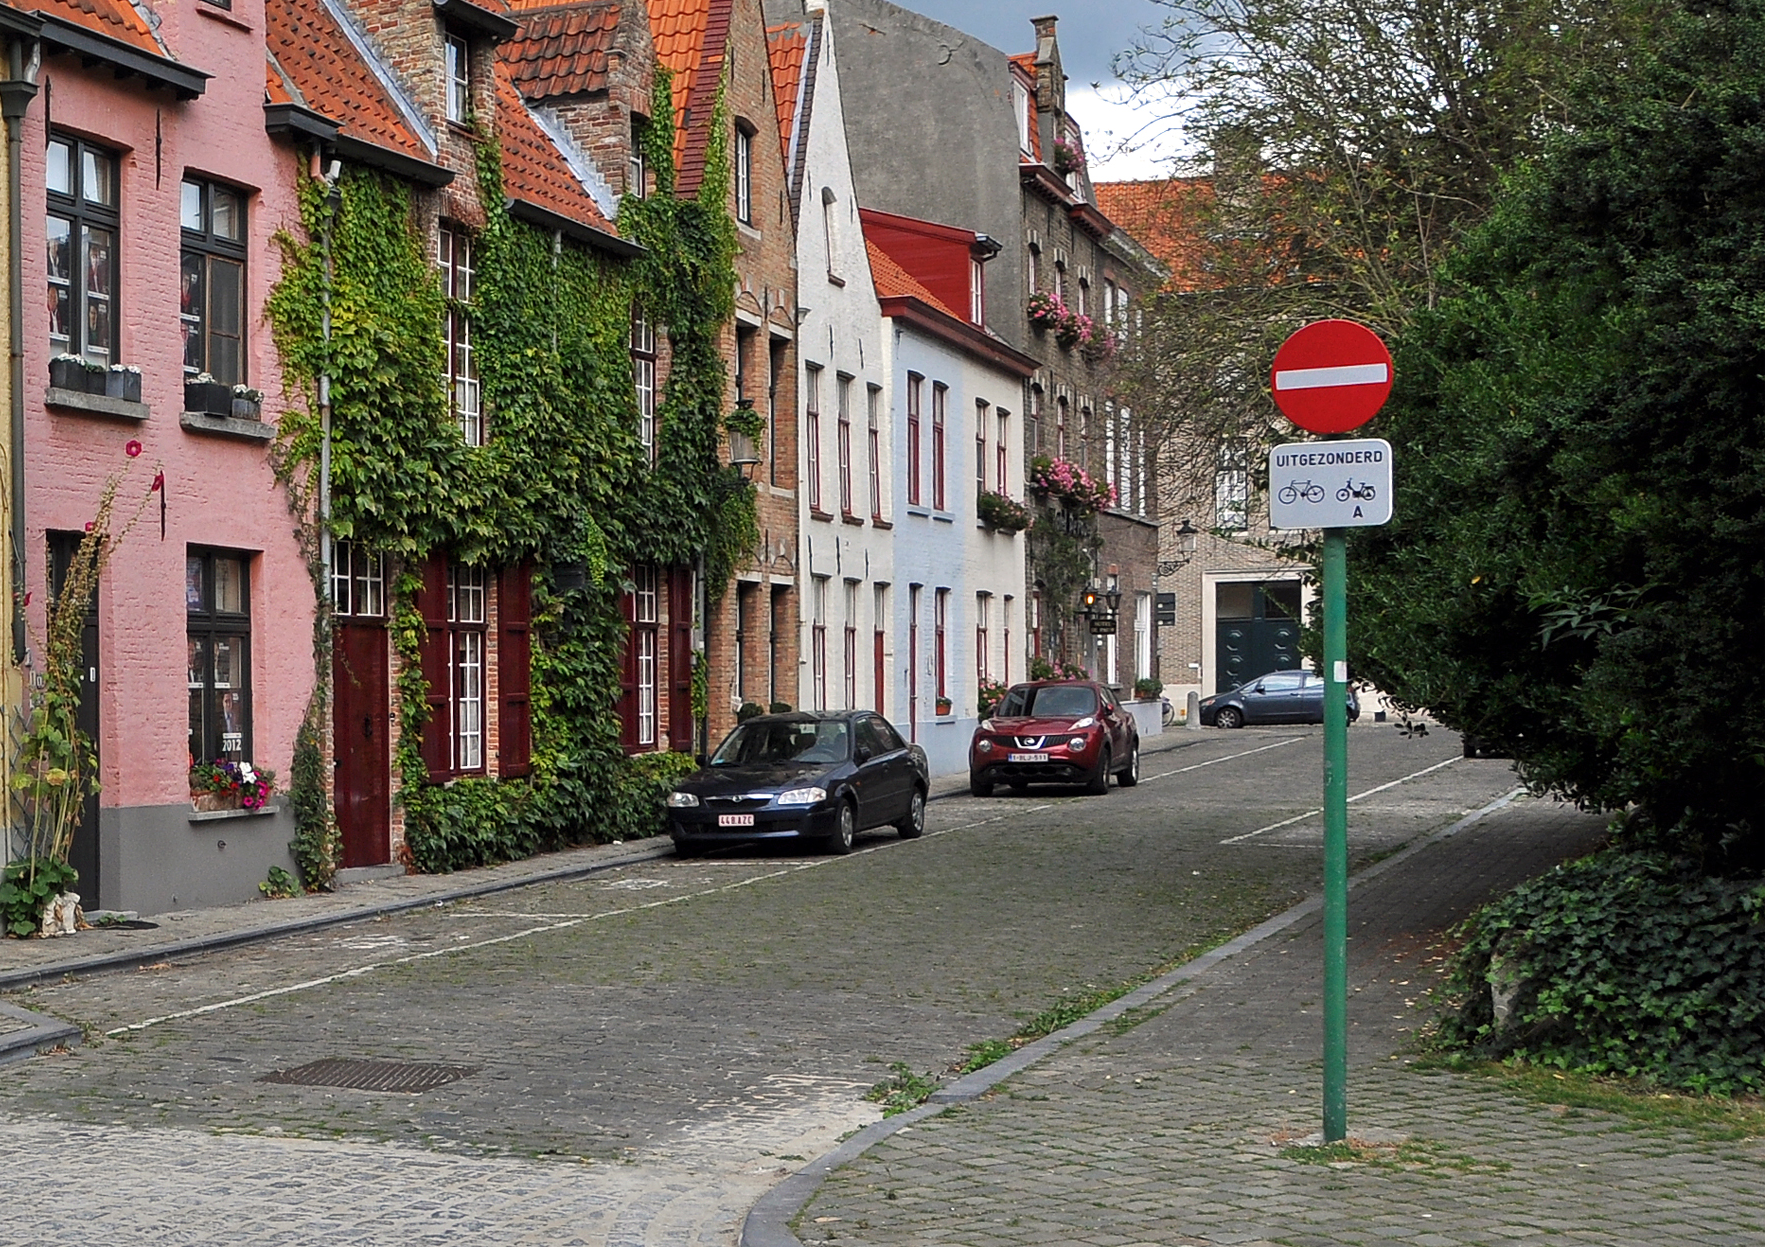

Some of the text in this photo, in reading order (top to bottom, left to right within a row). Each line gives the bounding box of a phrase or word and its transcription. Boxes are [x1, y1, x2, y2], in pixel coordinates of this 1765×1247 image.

[1276, 450, 1383, 468] UITGEZONDERD
[1352, 505, 1364, 519] A
[222, 738, 242, 752] 2012
